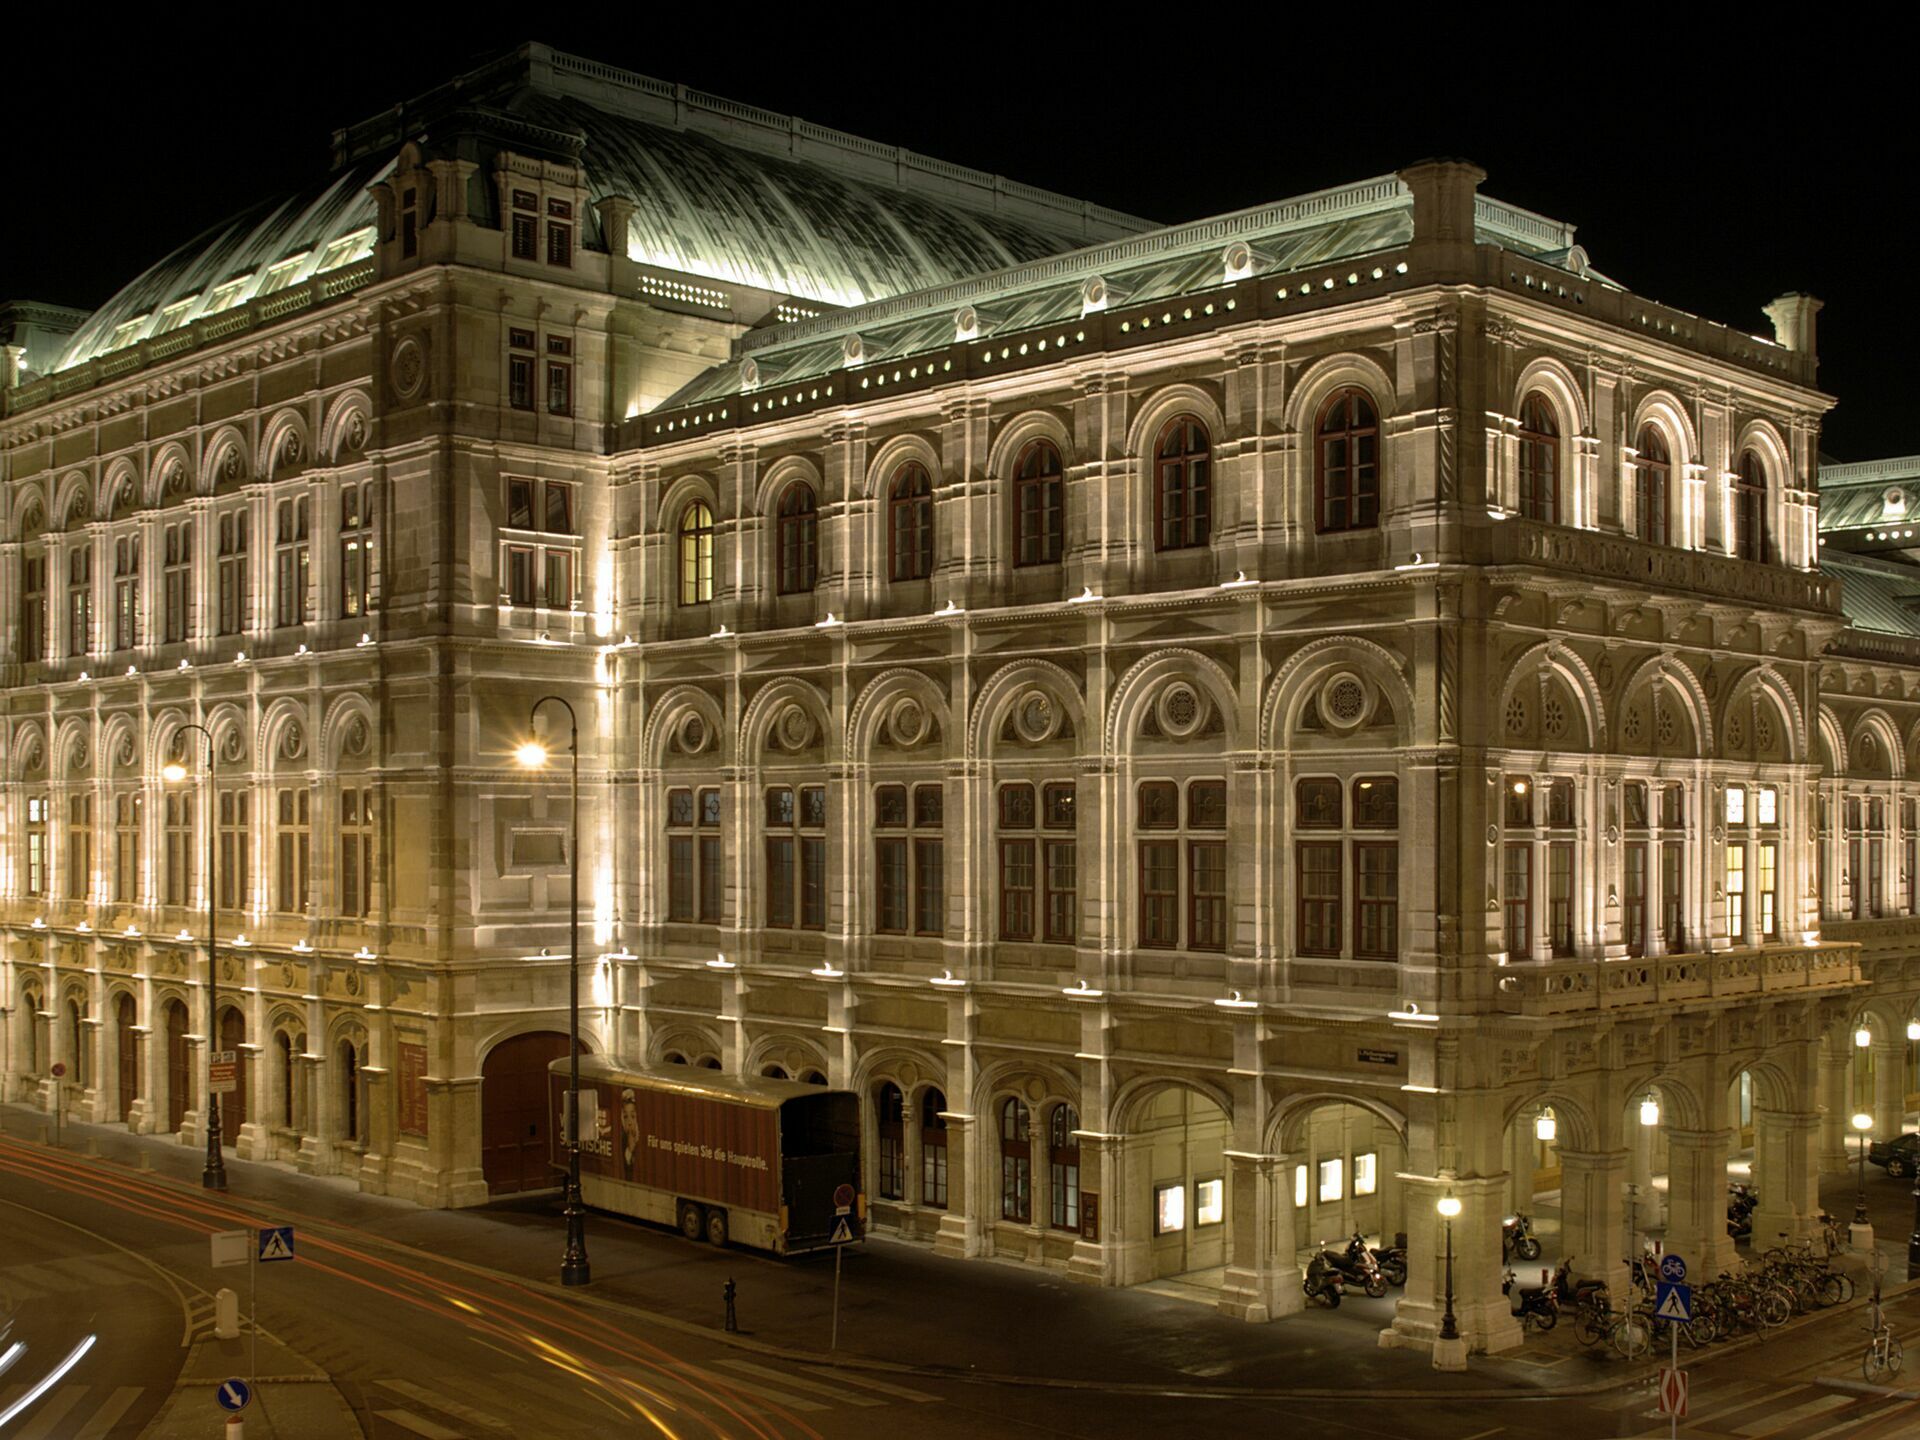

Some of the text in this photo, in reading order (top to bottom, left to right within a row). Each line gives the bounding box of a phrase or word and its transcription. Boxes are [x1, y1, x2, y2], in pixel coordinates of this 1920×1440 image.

[673, 1140, 699, 1156] spielen
[700, 1144, 713, 1159] Sie
[714, 1147, 726, 1162] die
